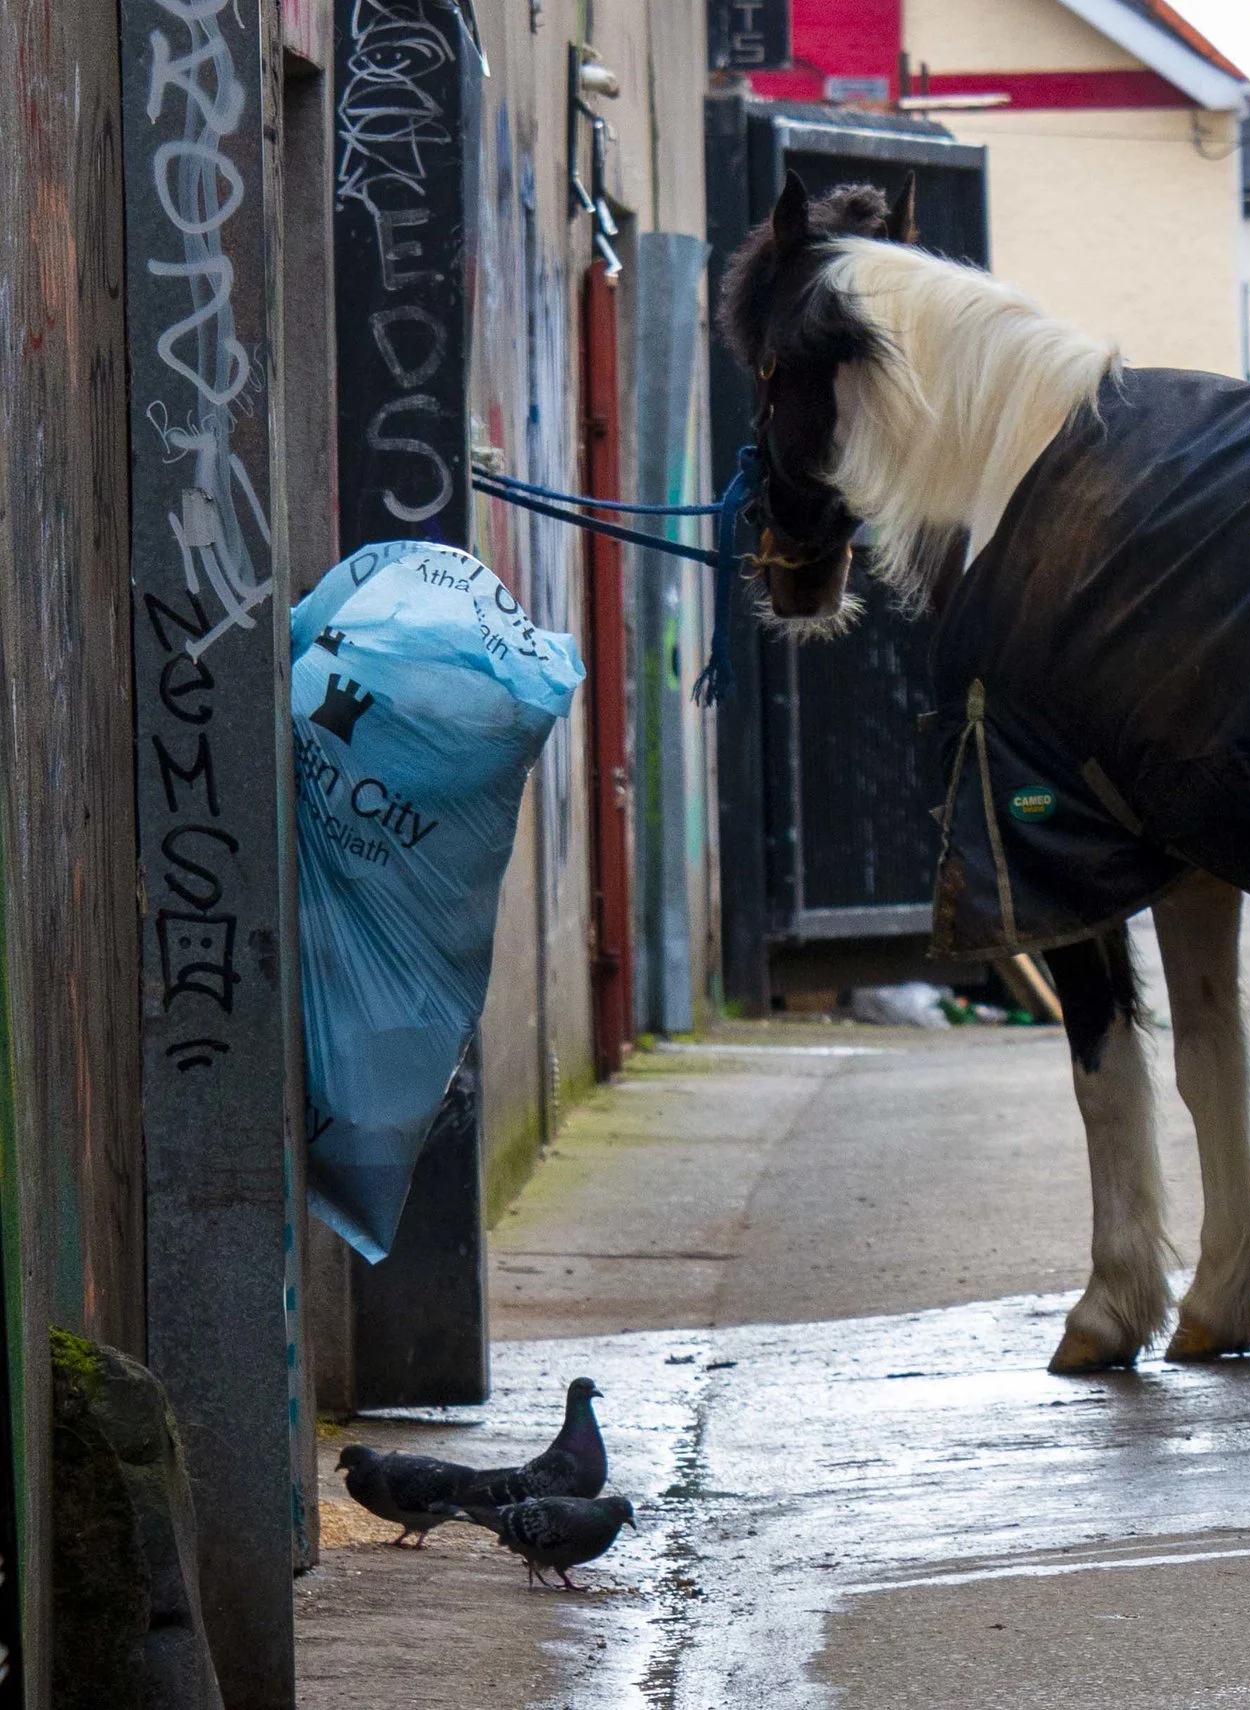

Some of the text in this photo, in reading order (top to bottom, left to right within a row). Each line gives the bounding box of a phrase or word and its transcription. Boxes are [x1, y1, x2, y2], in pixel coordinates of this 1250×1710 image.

[734, 1, 764, 63] TS
[324, 815, 390, 867] Cliath
[351, 778, 439, 849] City
